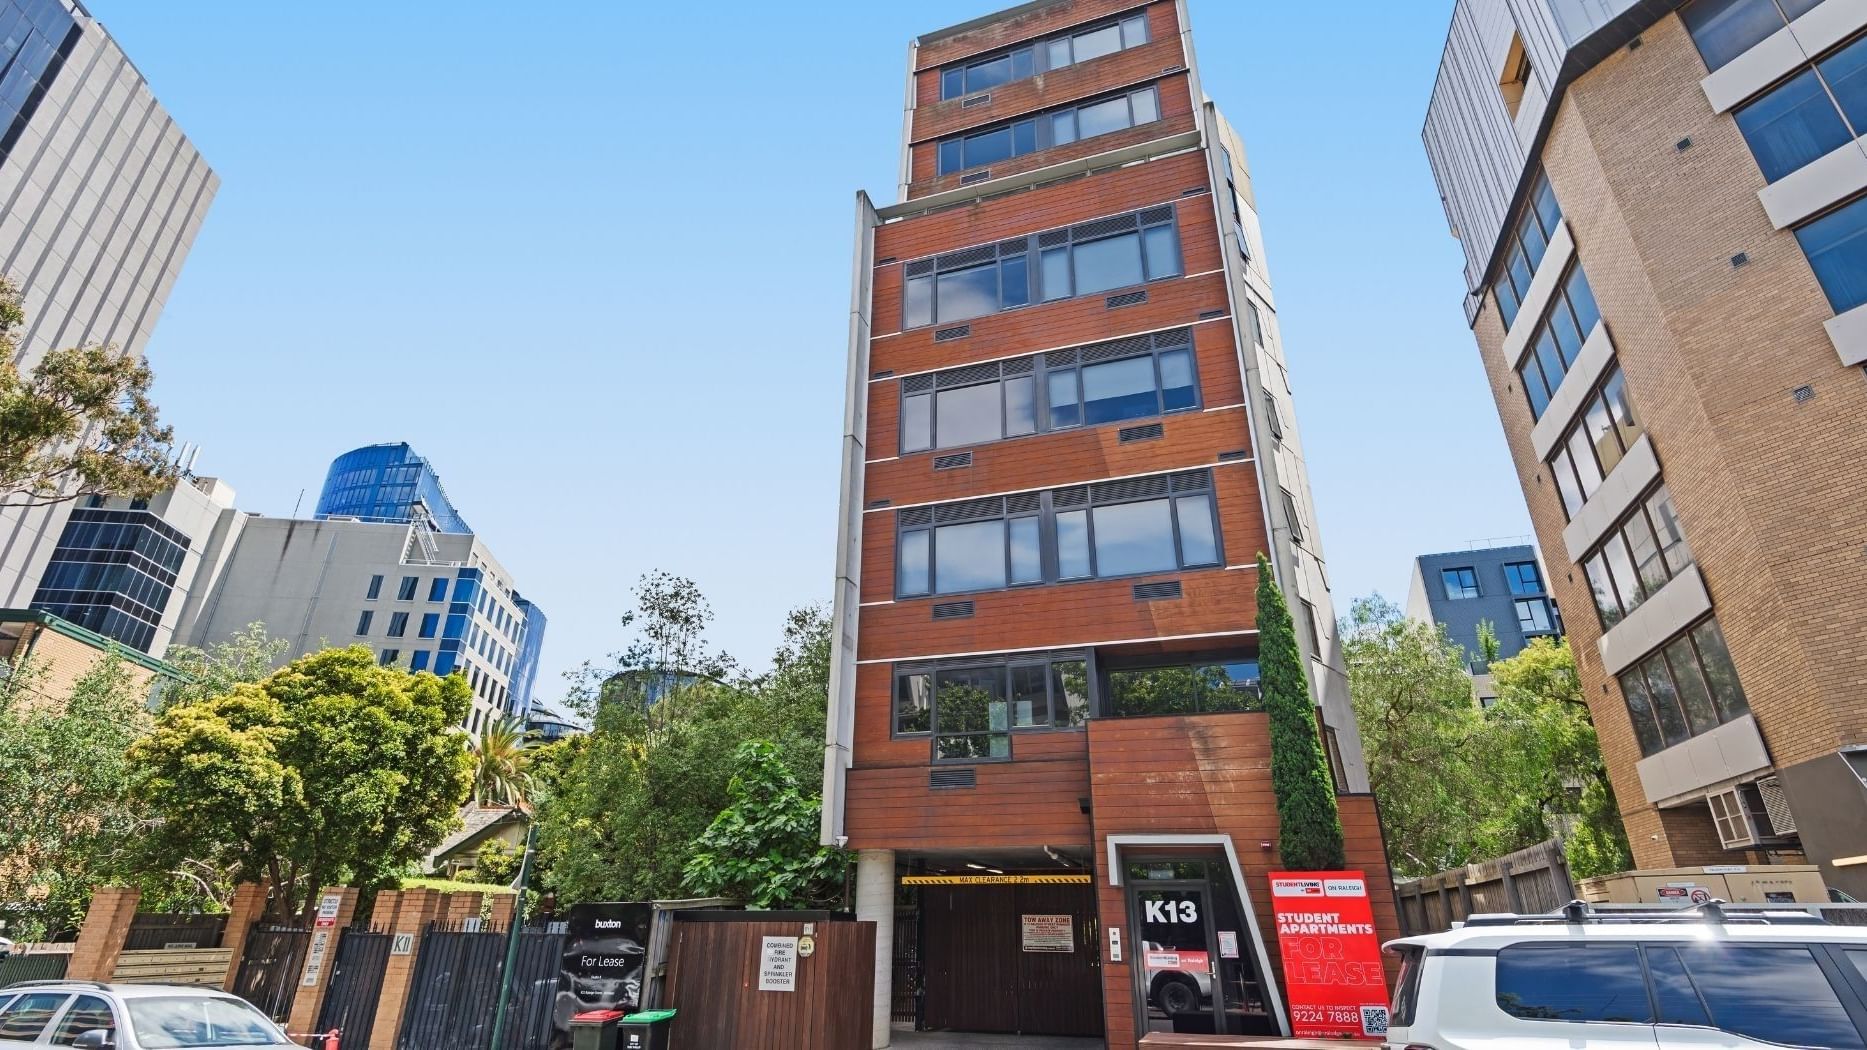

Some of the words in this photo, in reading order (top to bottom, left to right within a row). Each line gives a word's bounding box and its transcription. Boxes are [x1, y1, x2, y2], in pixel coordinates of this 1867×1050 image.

[1145, 900, 1198, 923] K13
[1277, 912, 1340, 923] STUDENT
[595, 919, 621, 929] buxton
[1280, 924, 1374, 935] APARTMENTS
[1280, 937, 1344, 960] FOR
[581, 955, 596, 967] For
[598, 955, 625, 967] Lease
[1284, 961, 1384, 986] LEASE
[1293, 1010, 1324, 1022] 9224
[1328, 1011, 1359, 1022] 7888
